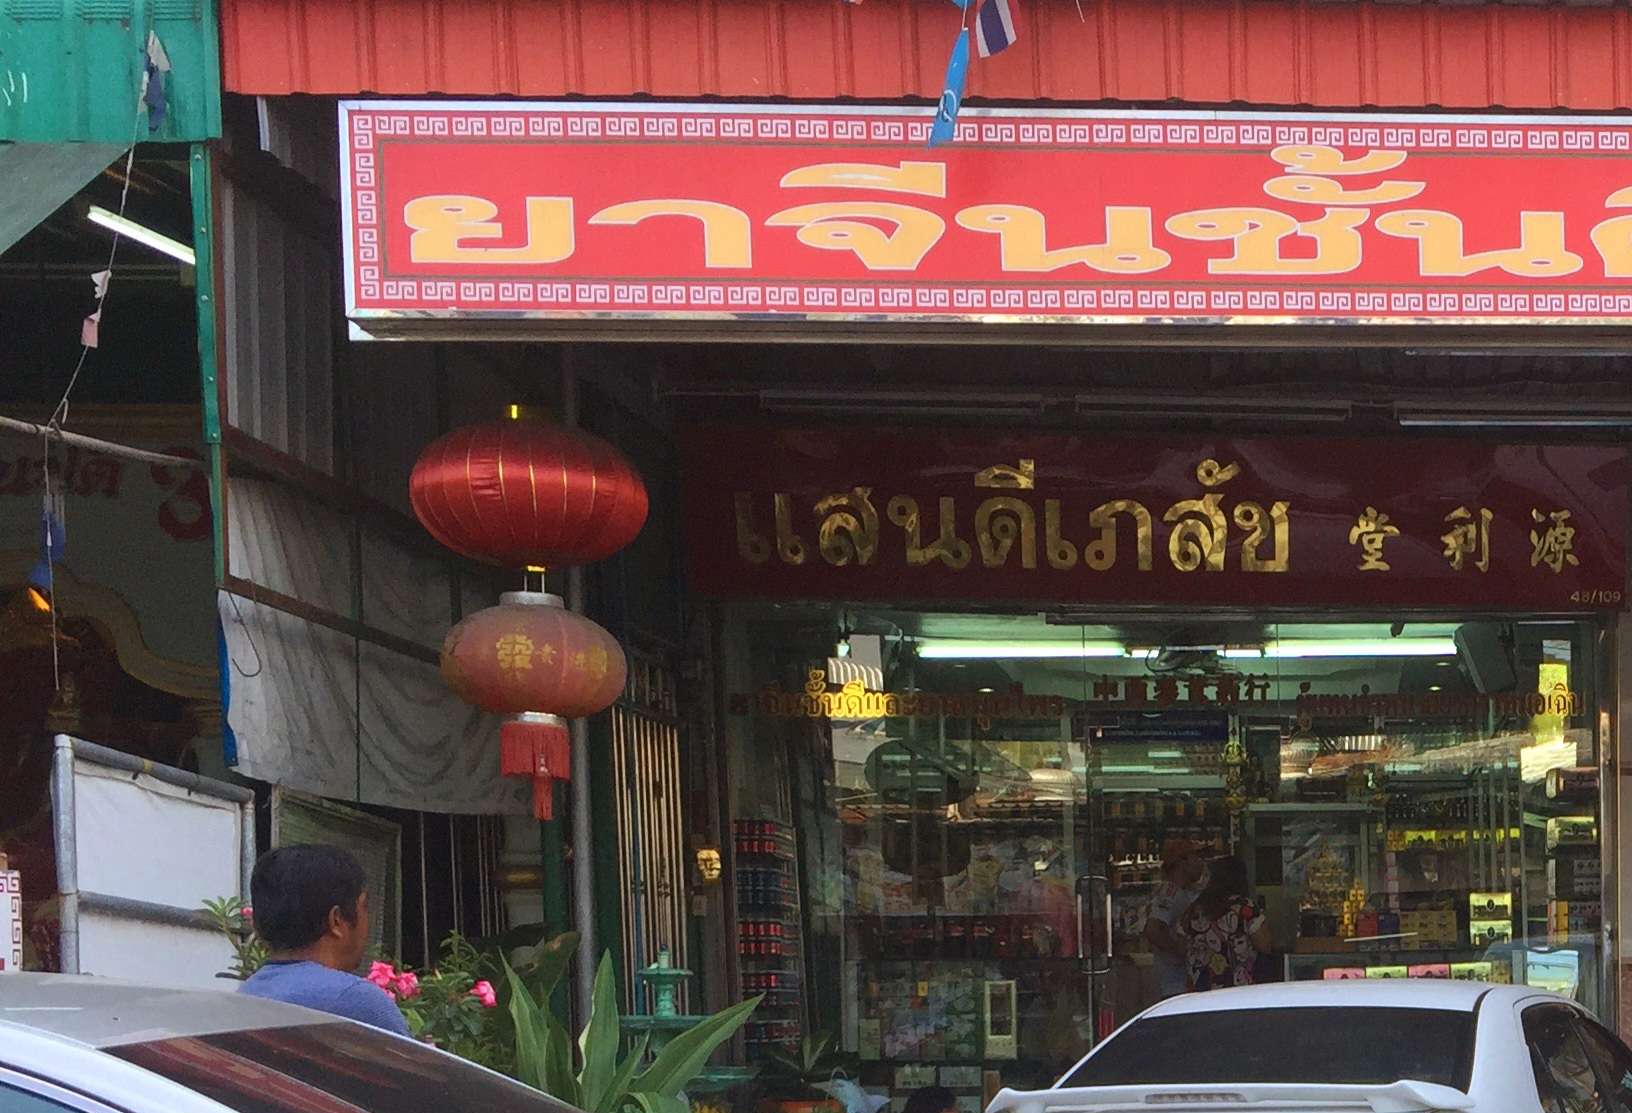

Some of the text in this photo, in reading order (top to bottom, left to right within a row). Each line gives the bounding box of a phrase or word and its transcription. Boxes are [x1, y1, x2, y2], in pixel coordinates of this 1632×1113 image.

[734, 458, 1292, 574] แสนดีเภสัช
[1569, 589, 1622, 604] 48/109
